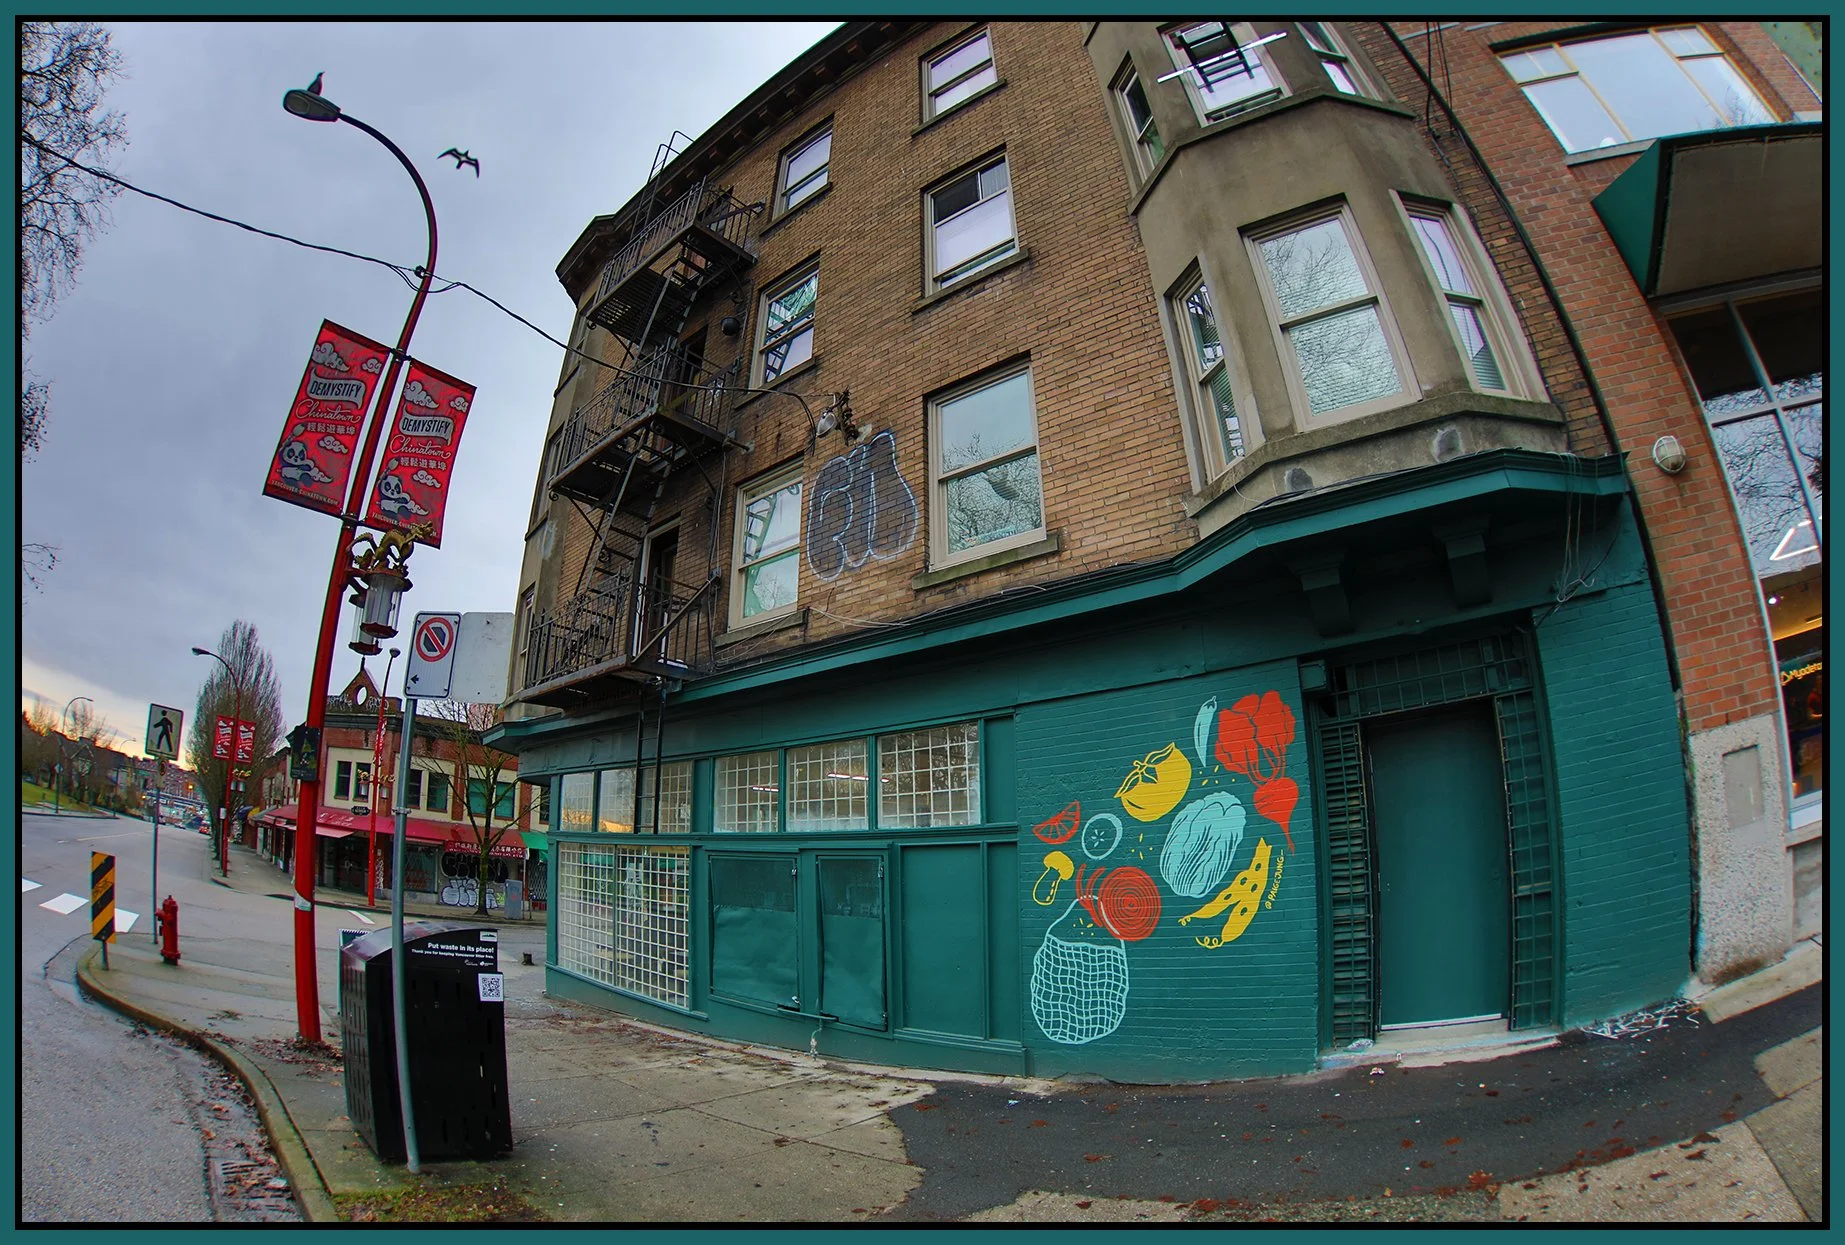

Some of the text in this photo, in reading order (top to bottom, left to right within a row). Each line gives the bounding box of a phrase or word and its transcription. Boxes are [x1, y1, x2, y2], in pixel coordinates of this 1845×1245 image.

[309, 380, 362, 398] DEMYSTIFY
[295, 398, 361, 423] Chinatown
[401, 417, 451, 434] DEMYSTIFY
[390, 434, 451, 459] Chinatown
